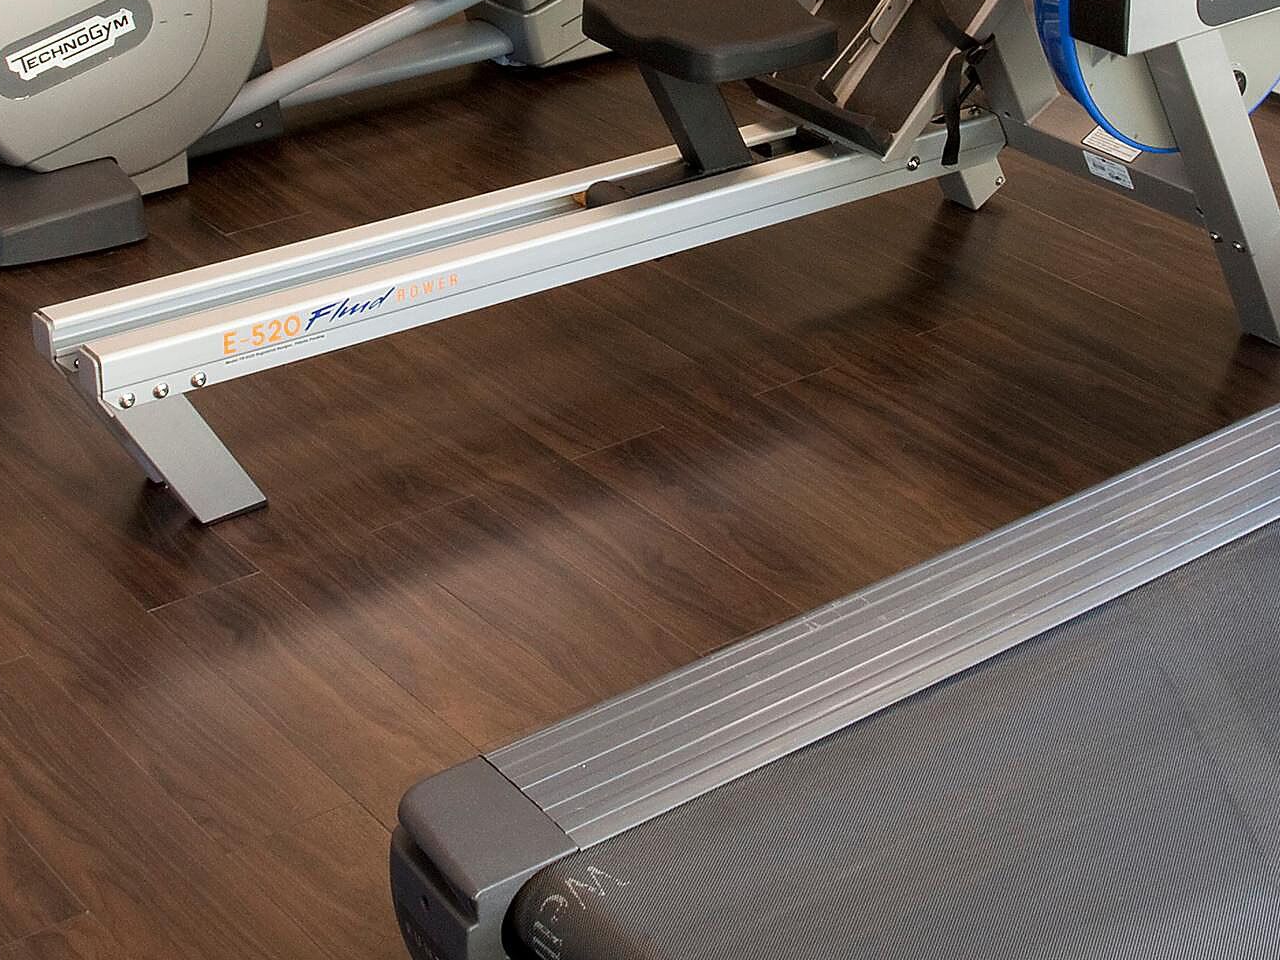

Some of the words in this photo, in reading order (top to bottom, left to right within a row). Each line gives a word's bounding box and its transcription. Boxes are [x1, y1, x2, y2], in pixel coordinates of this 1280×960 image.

[11, 15, 129, 74] TECHNOGYM
[223, 314, 301, 355] E-520
[305, 286, 396, 331] Fluid
[396, 273, 459, 303] ROWER
